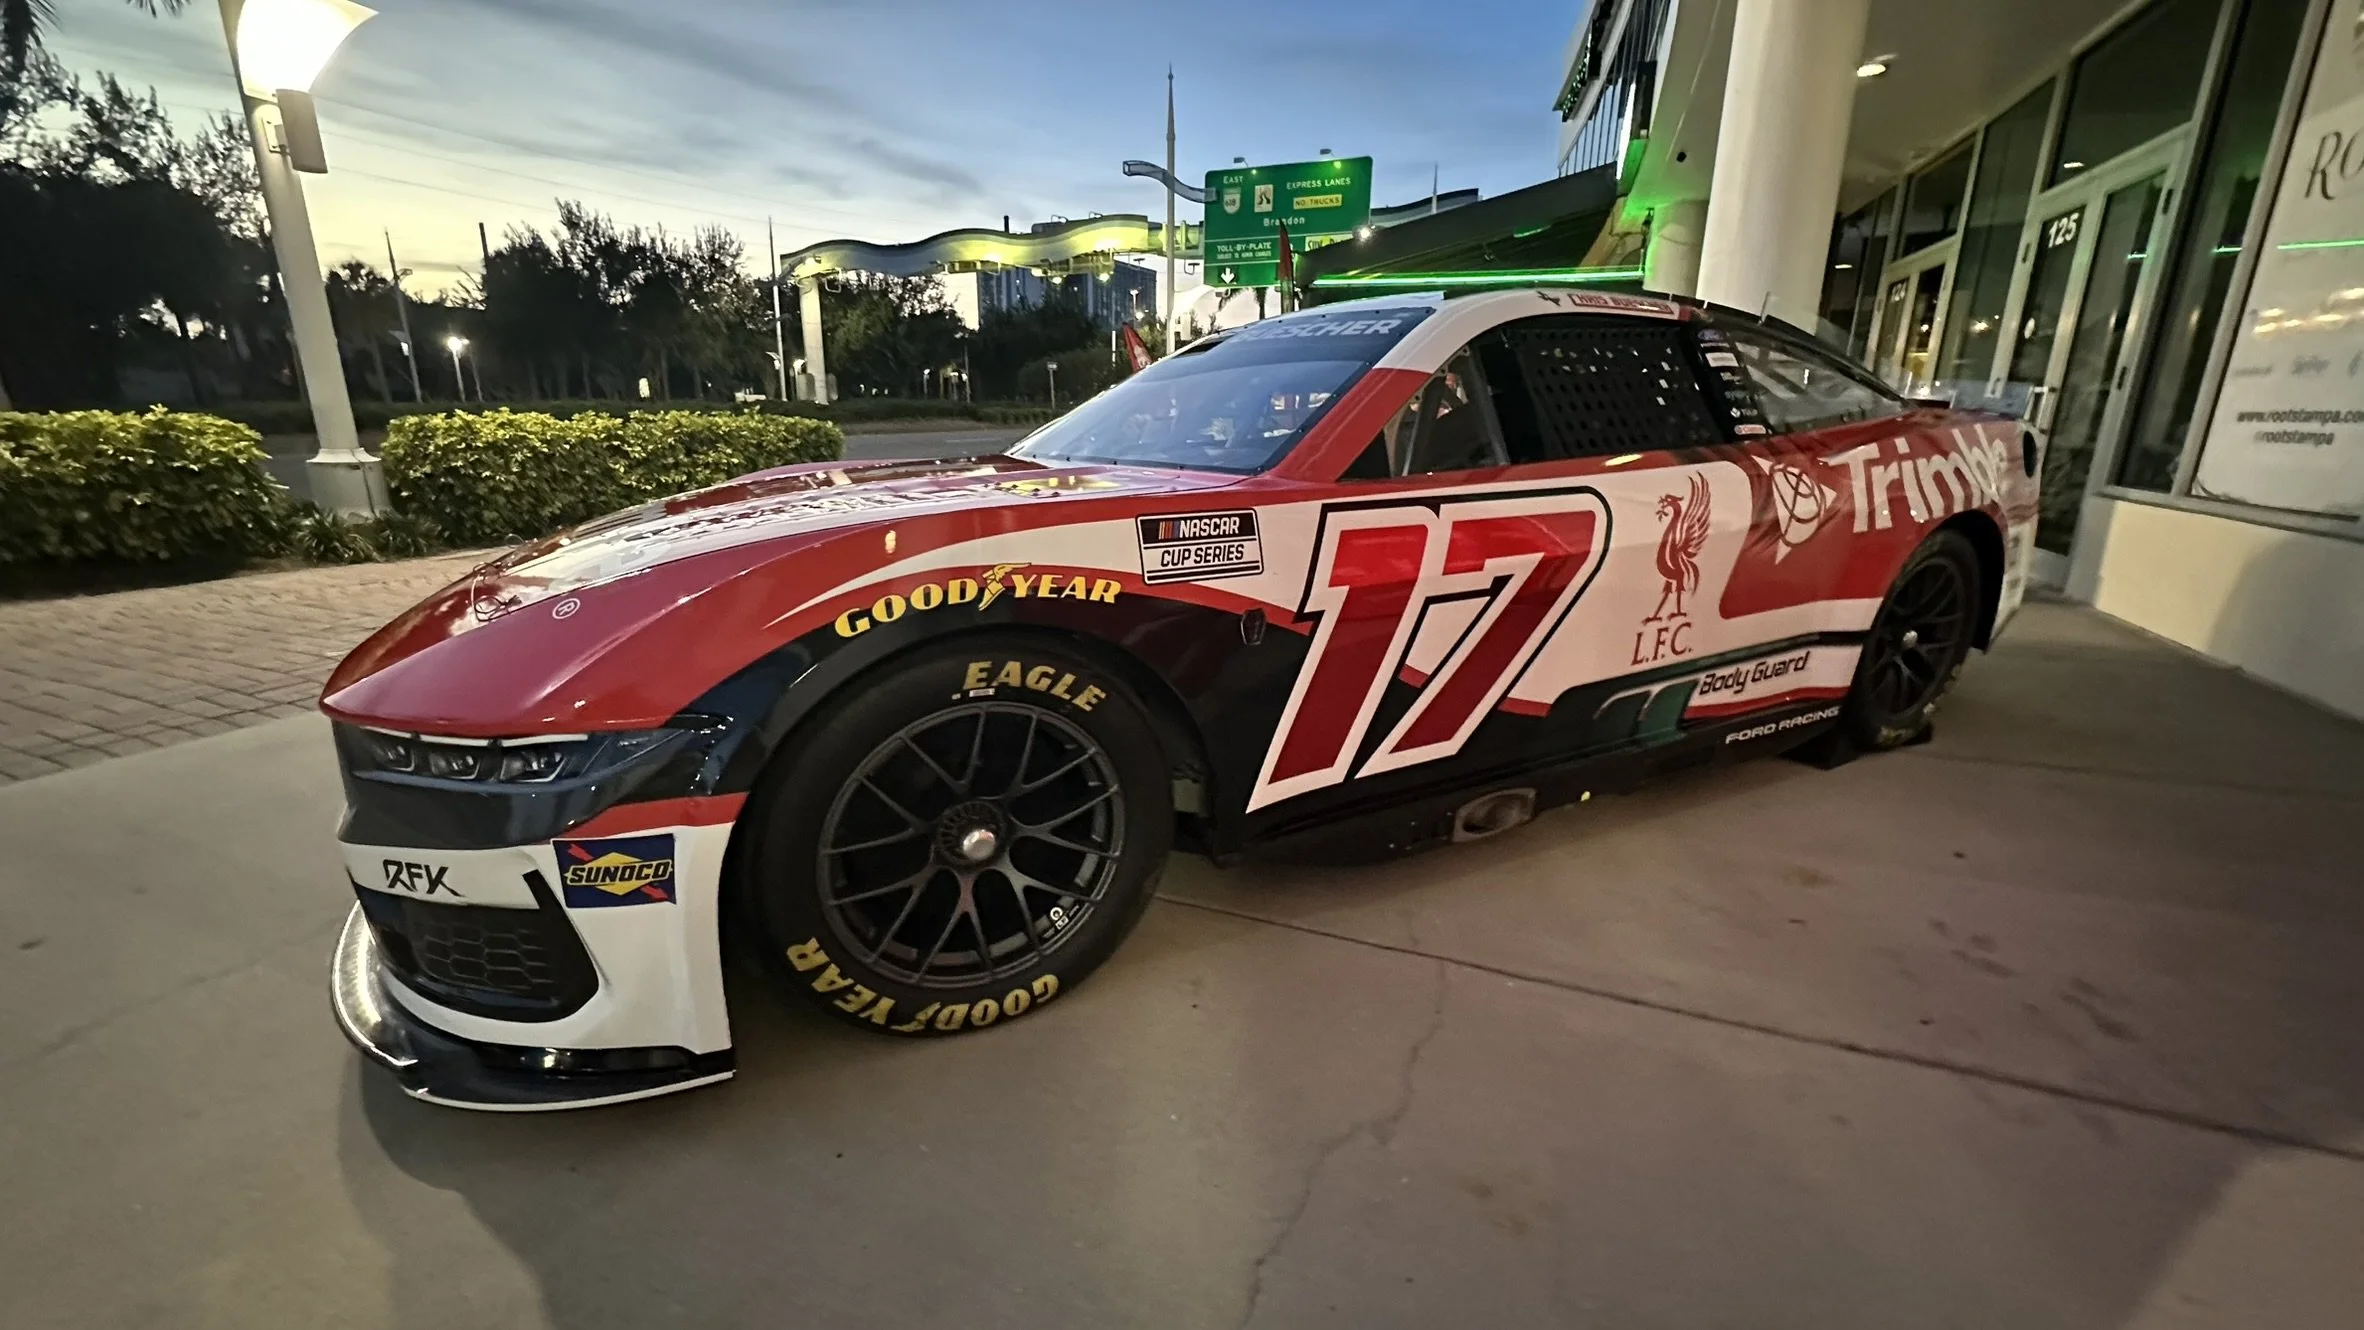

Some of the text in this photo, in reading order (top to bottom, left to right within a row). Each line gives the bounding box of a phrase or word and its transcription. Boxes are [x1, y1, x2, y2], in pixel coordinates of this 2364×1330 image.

[1223, 175, 1244, 184] EAST
[1286, 177, 1351, 190] EXPRESS LANES
[1310, 197, 1340, 206] TRUCKS
[1263, 217, 1305, 226] Brandon
[2048, 212, 2079, 248] 125
[1816, 422, 2009, 534] Trimble
[1179, 516, 1240, 539] NASCAR
[1160, 543, 1245, 568] CUP SERIES
[1246, 494, 1604, 815] 17
[1630, 622, 1692, 666] L.F.C.
[962, 660, 1107, 712] EAGLE
[1699, 650, 1811, 695] Body Guard
[1725, 704, 1842, 745] FORD RACING
[567, 859, 672, 886] SUNOCO
